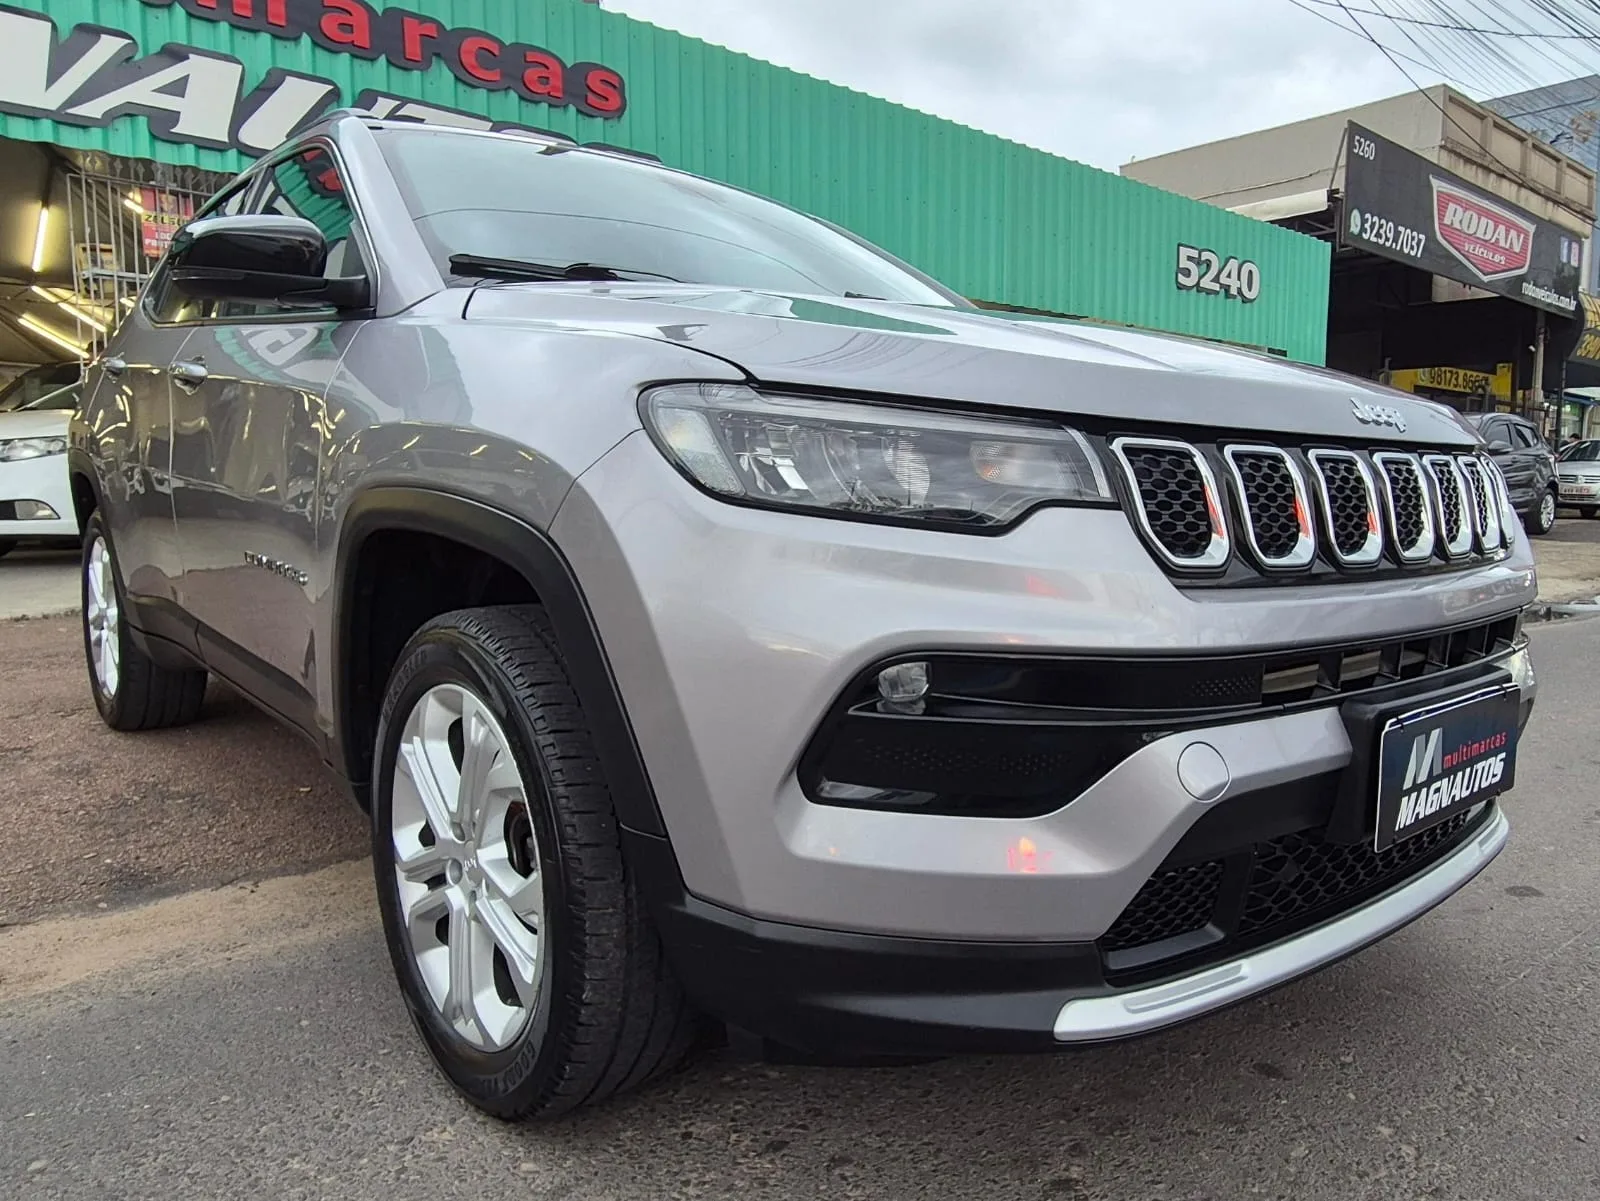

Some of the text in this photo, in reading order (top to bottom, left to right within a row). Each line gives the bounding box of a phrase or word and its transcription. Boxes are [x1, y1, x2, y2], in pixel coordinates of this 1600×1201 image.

[1353, 136, 1376, 160] 5260
[1362, 213, 1426, 258] 3239.7037
[1443, 202, 1524, 253] RODAN
[1177, 245, 1260, 301] 5240
[1350, 397, 1407, 434] Jeep
[1444, 731, 1508, 769] multimarcas
[1395, 752, 1507, 832] MAGNAUTOS
